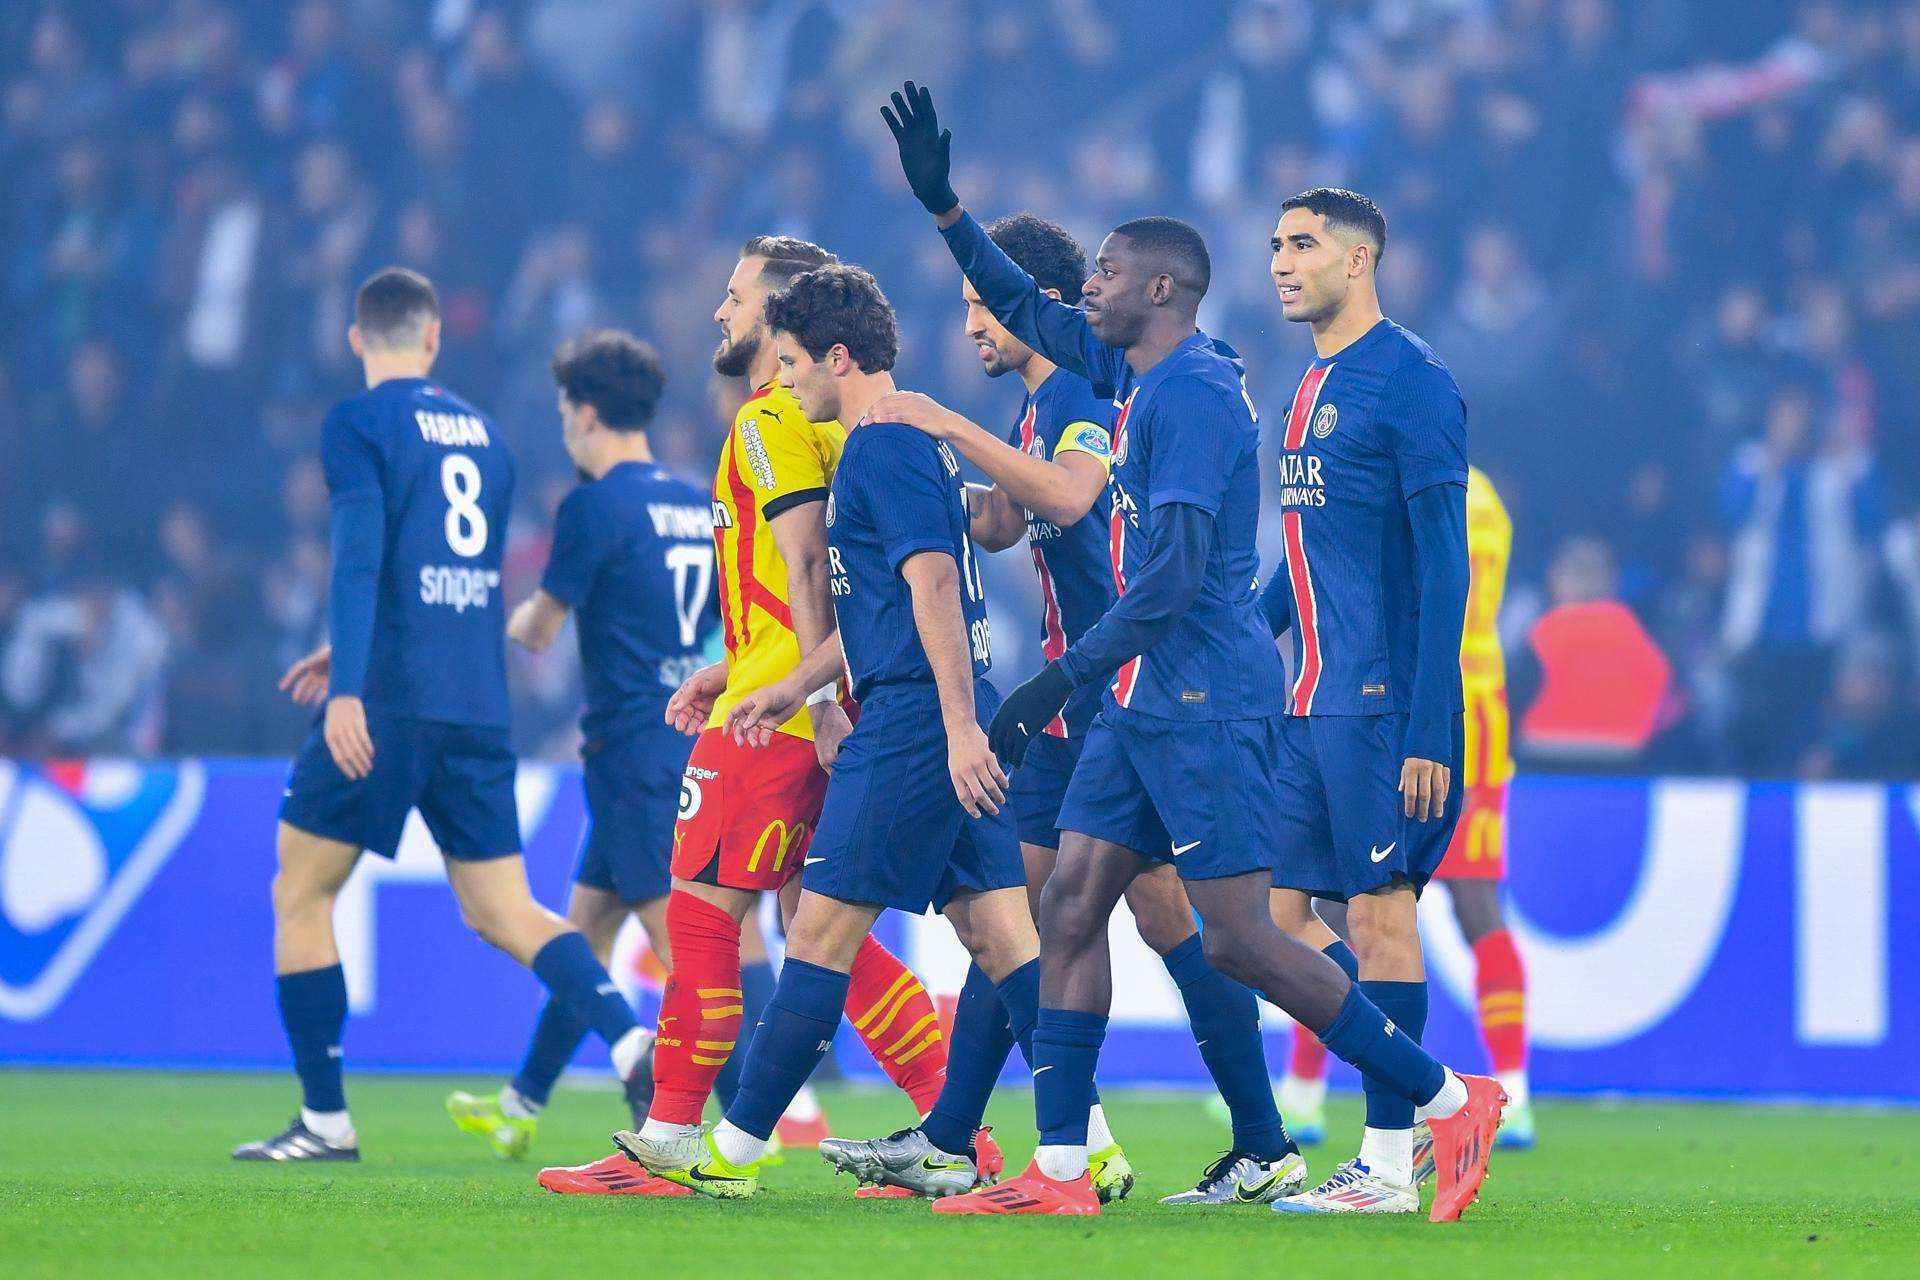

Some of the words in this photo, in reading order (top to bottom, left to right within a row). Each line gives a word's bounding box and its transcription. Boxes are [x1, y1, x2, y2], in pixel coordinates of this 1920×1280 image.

[747, 420, 776, 490] AUSHOPPING
[1279, 455, 1325, 486] ATAR
[441, 453, 488, 558] 8
[1281, 487, 1326, 507] IRWAYS
